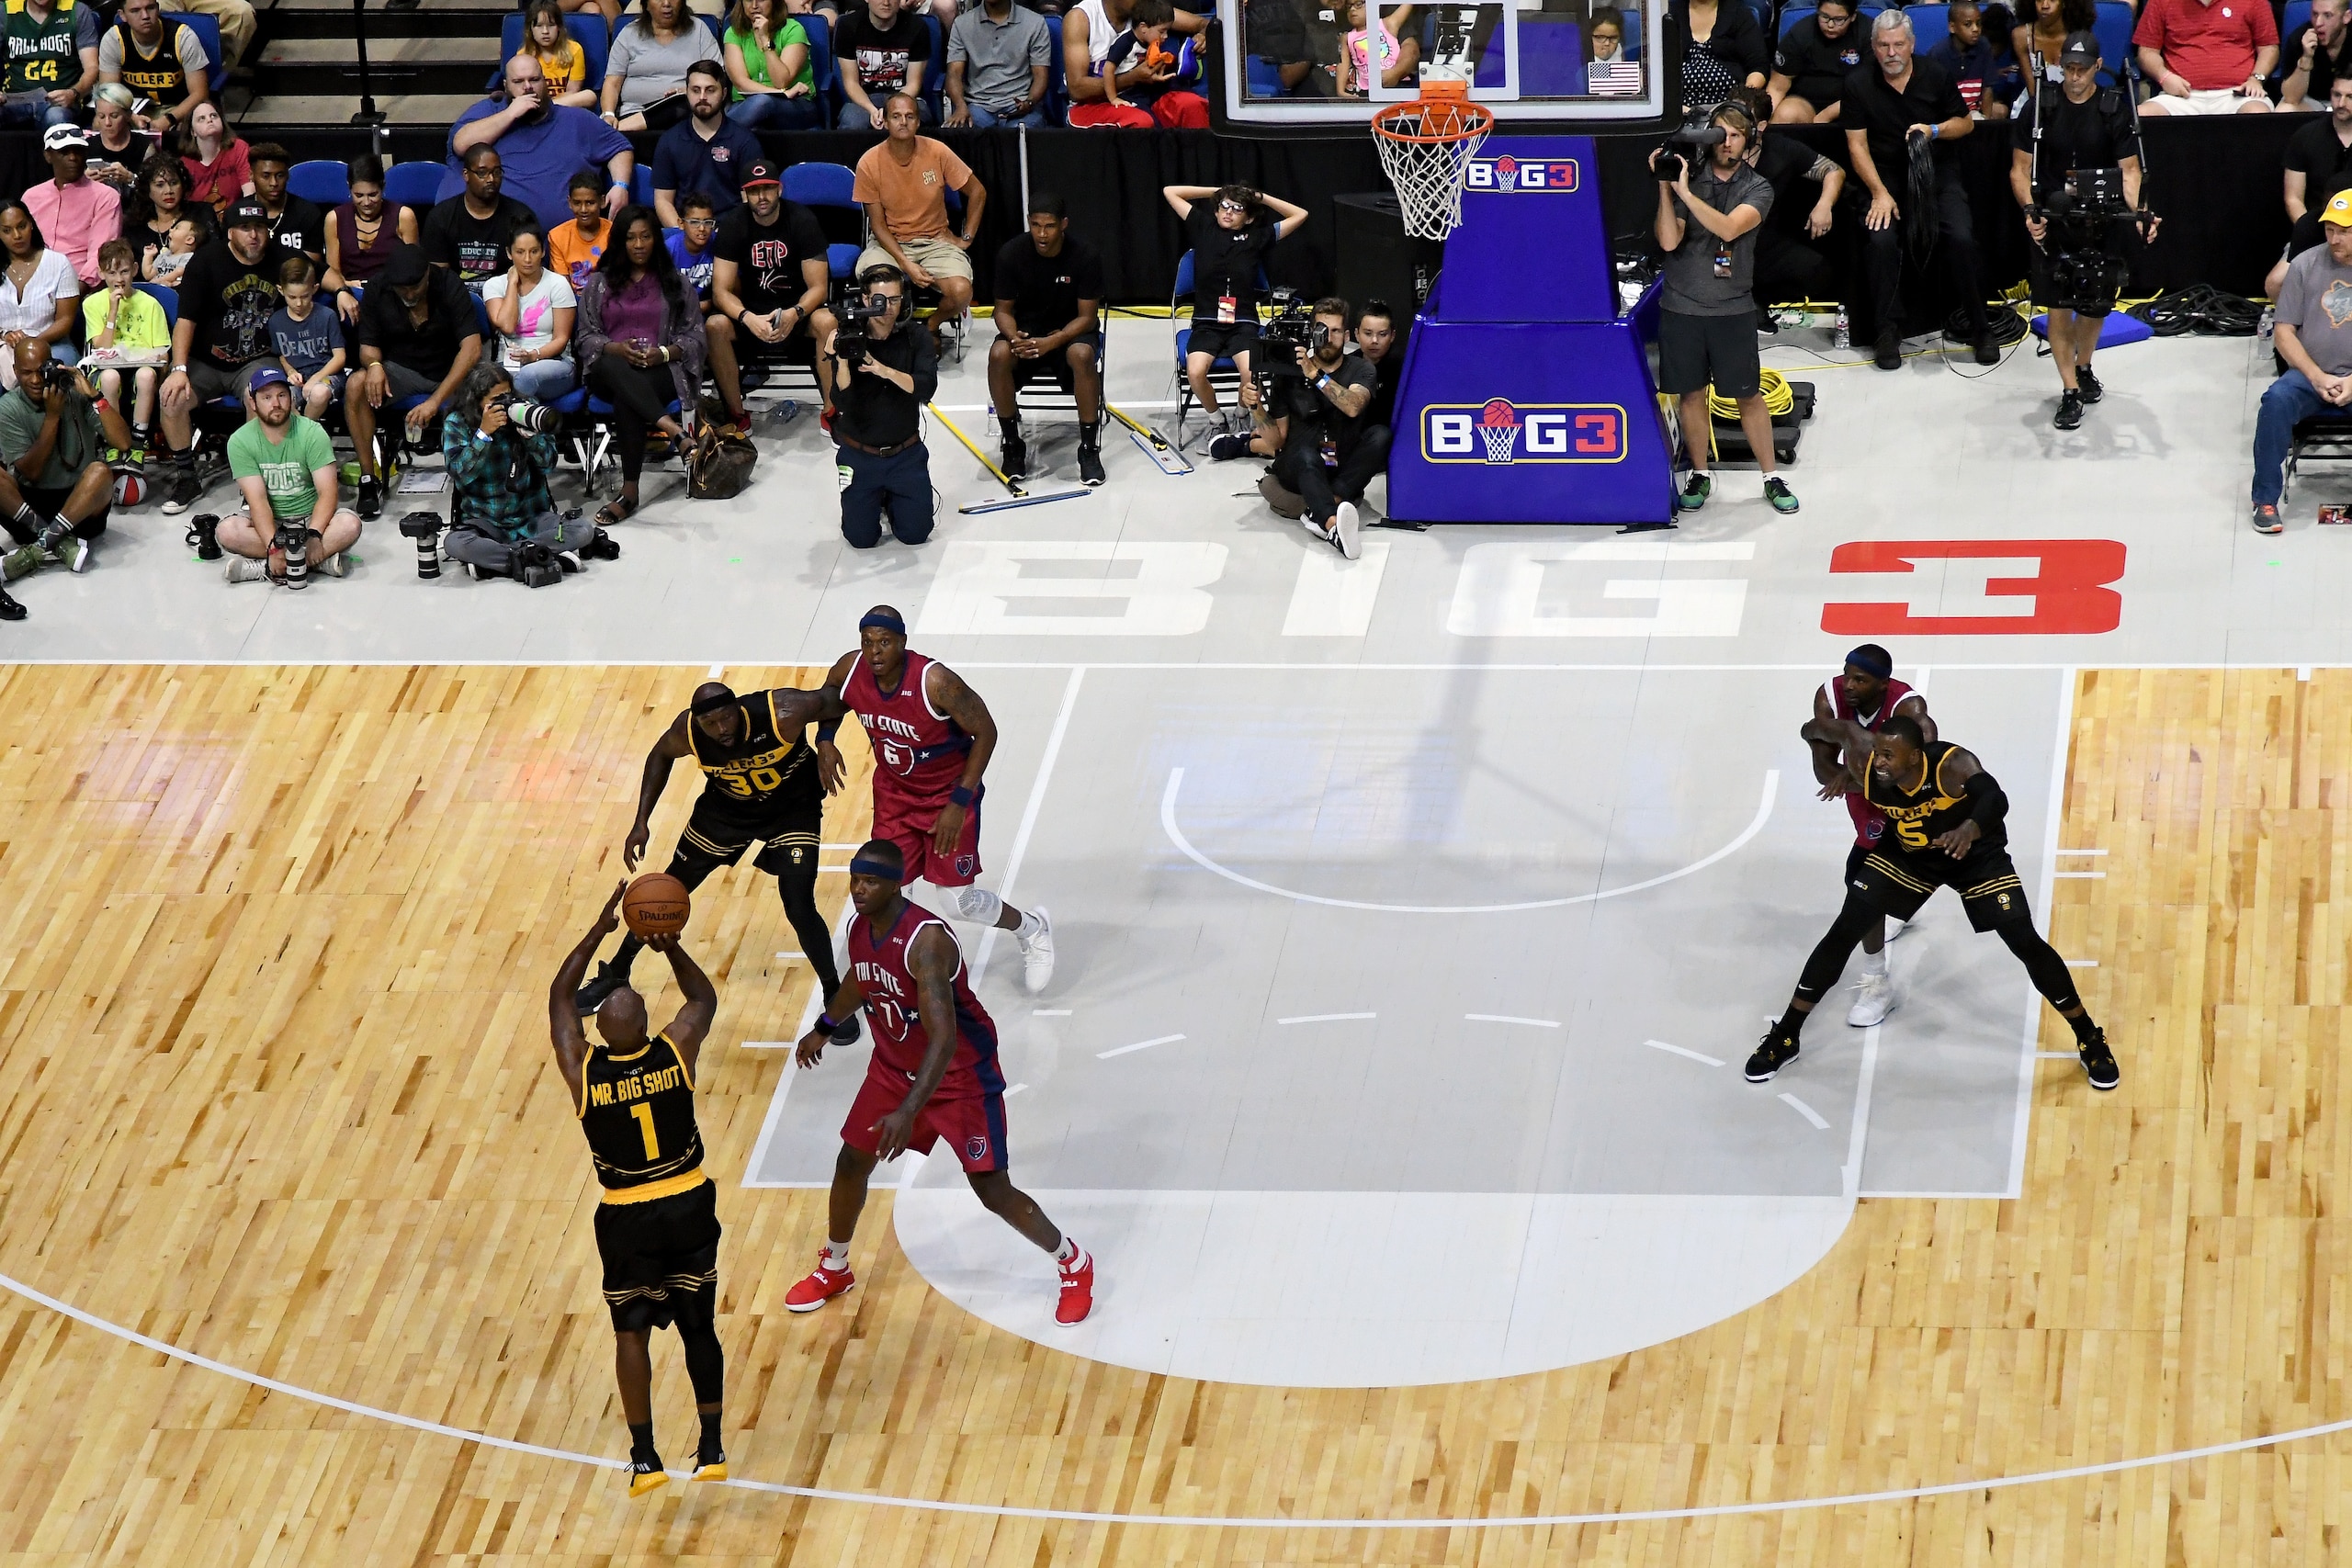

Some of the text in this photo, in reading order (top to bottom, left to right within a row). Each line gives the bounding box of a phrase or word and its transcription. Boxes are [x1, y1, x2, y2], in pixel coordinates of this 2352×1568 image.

[40, 33, 72, 56] HOGS
[281, 231, 302, 250] 96
[752, 239, 788, 268] ETP
[876, 715, 922, 742] STATE
[883, 743, 901, 765] 6
[719, 767, 782, 795] 30
[1896, 818, 1929, 847] 5
[639, 908, 684, 921] SPALDING
[871, 962, 906, 998] SATE
[879, 1001, 894, 1029] 7
[590, 1065, 680, 1108] MR. BIG SHOT
[629, 1101, 661, 1162] 1
